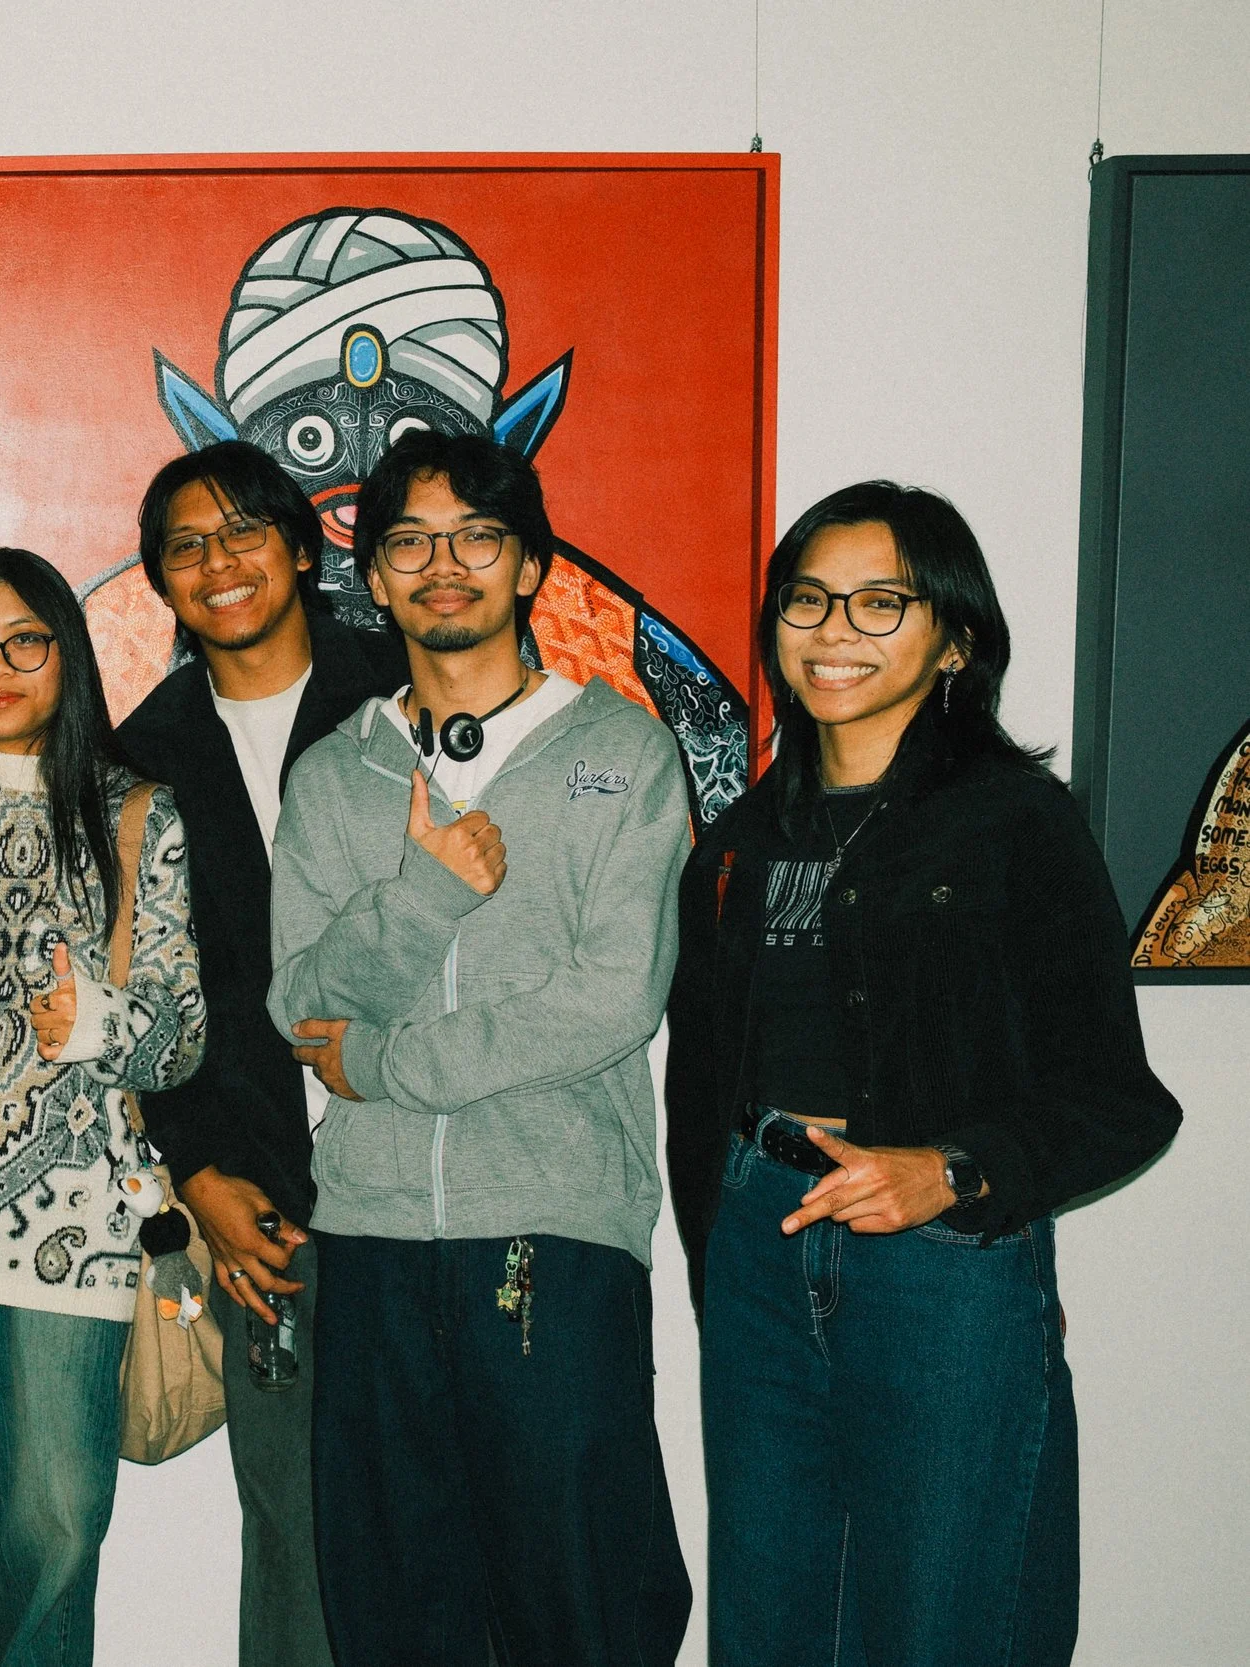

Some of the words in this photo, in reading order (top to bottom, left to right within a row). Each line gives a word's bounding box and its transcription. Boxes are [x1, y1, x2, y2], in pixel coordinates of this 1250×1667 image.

[1201, 824, 1249, 846] SOME
[1200, 856, 1240, 875] EGGS
[1134, 944, 1153, 965] Dr.
